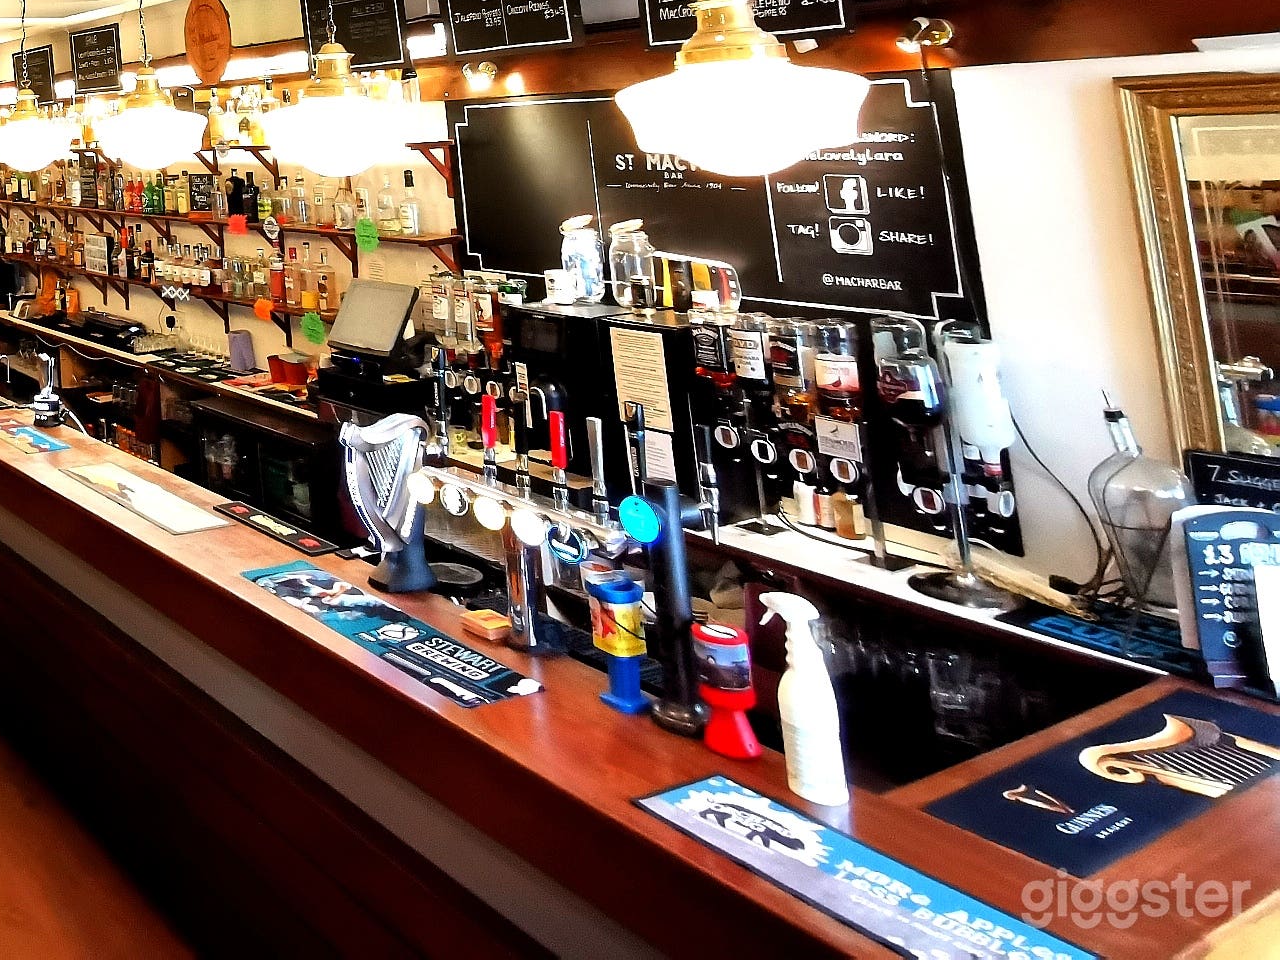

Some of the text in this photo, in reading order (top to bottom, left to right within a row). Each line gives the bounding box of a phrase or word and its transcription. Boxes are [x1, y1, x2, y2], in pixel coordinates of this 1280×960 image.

[663, 171, 684, 180] BAR
[876, 186, 926, 200] LIKE!
[786, 223, 935, 246] TAG! SHARE!
[416, 646, 483, 678] BREWING
[424, 637, 507, 672] STEWART
